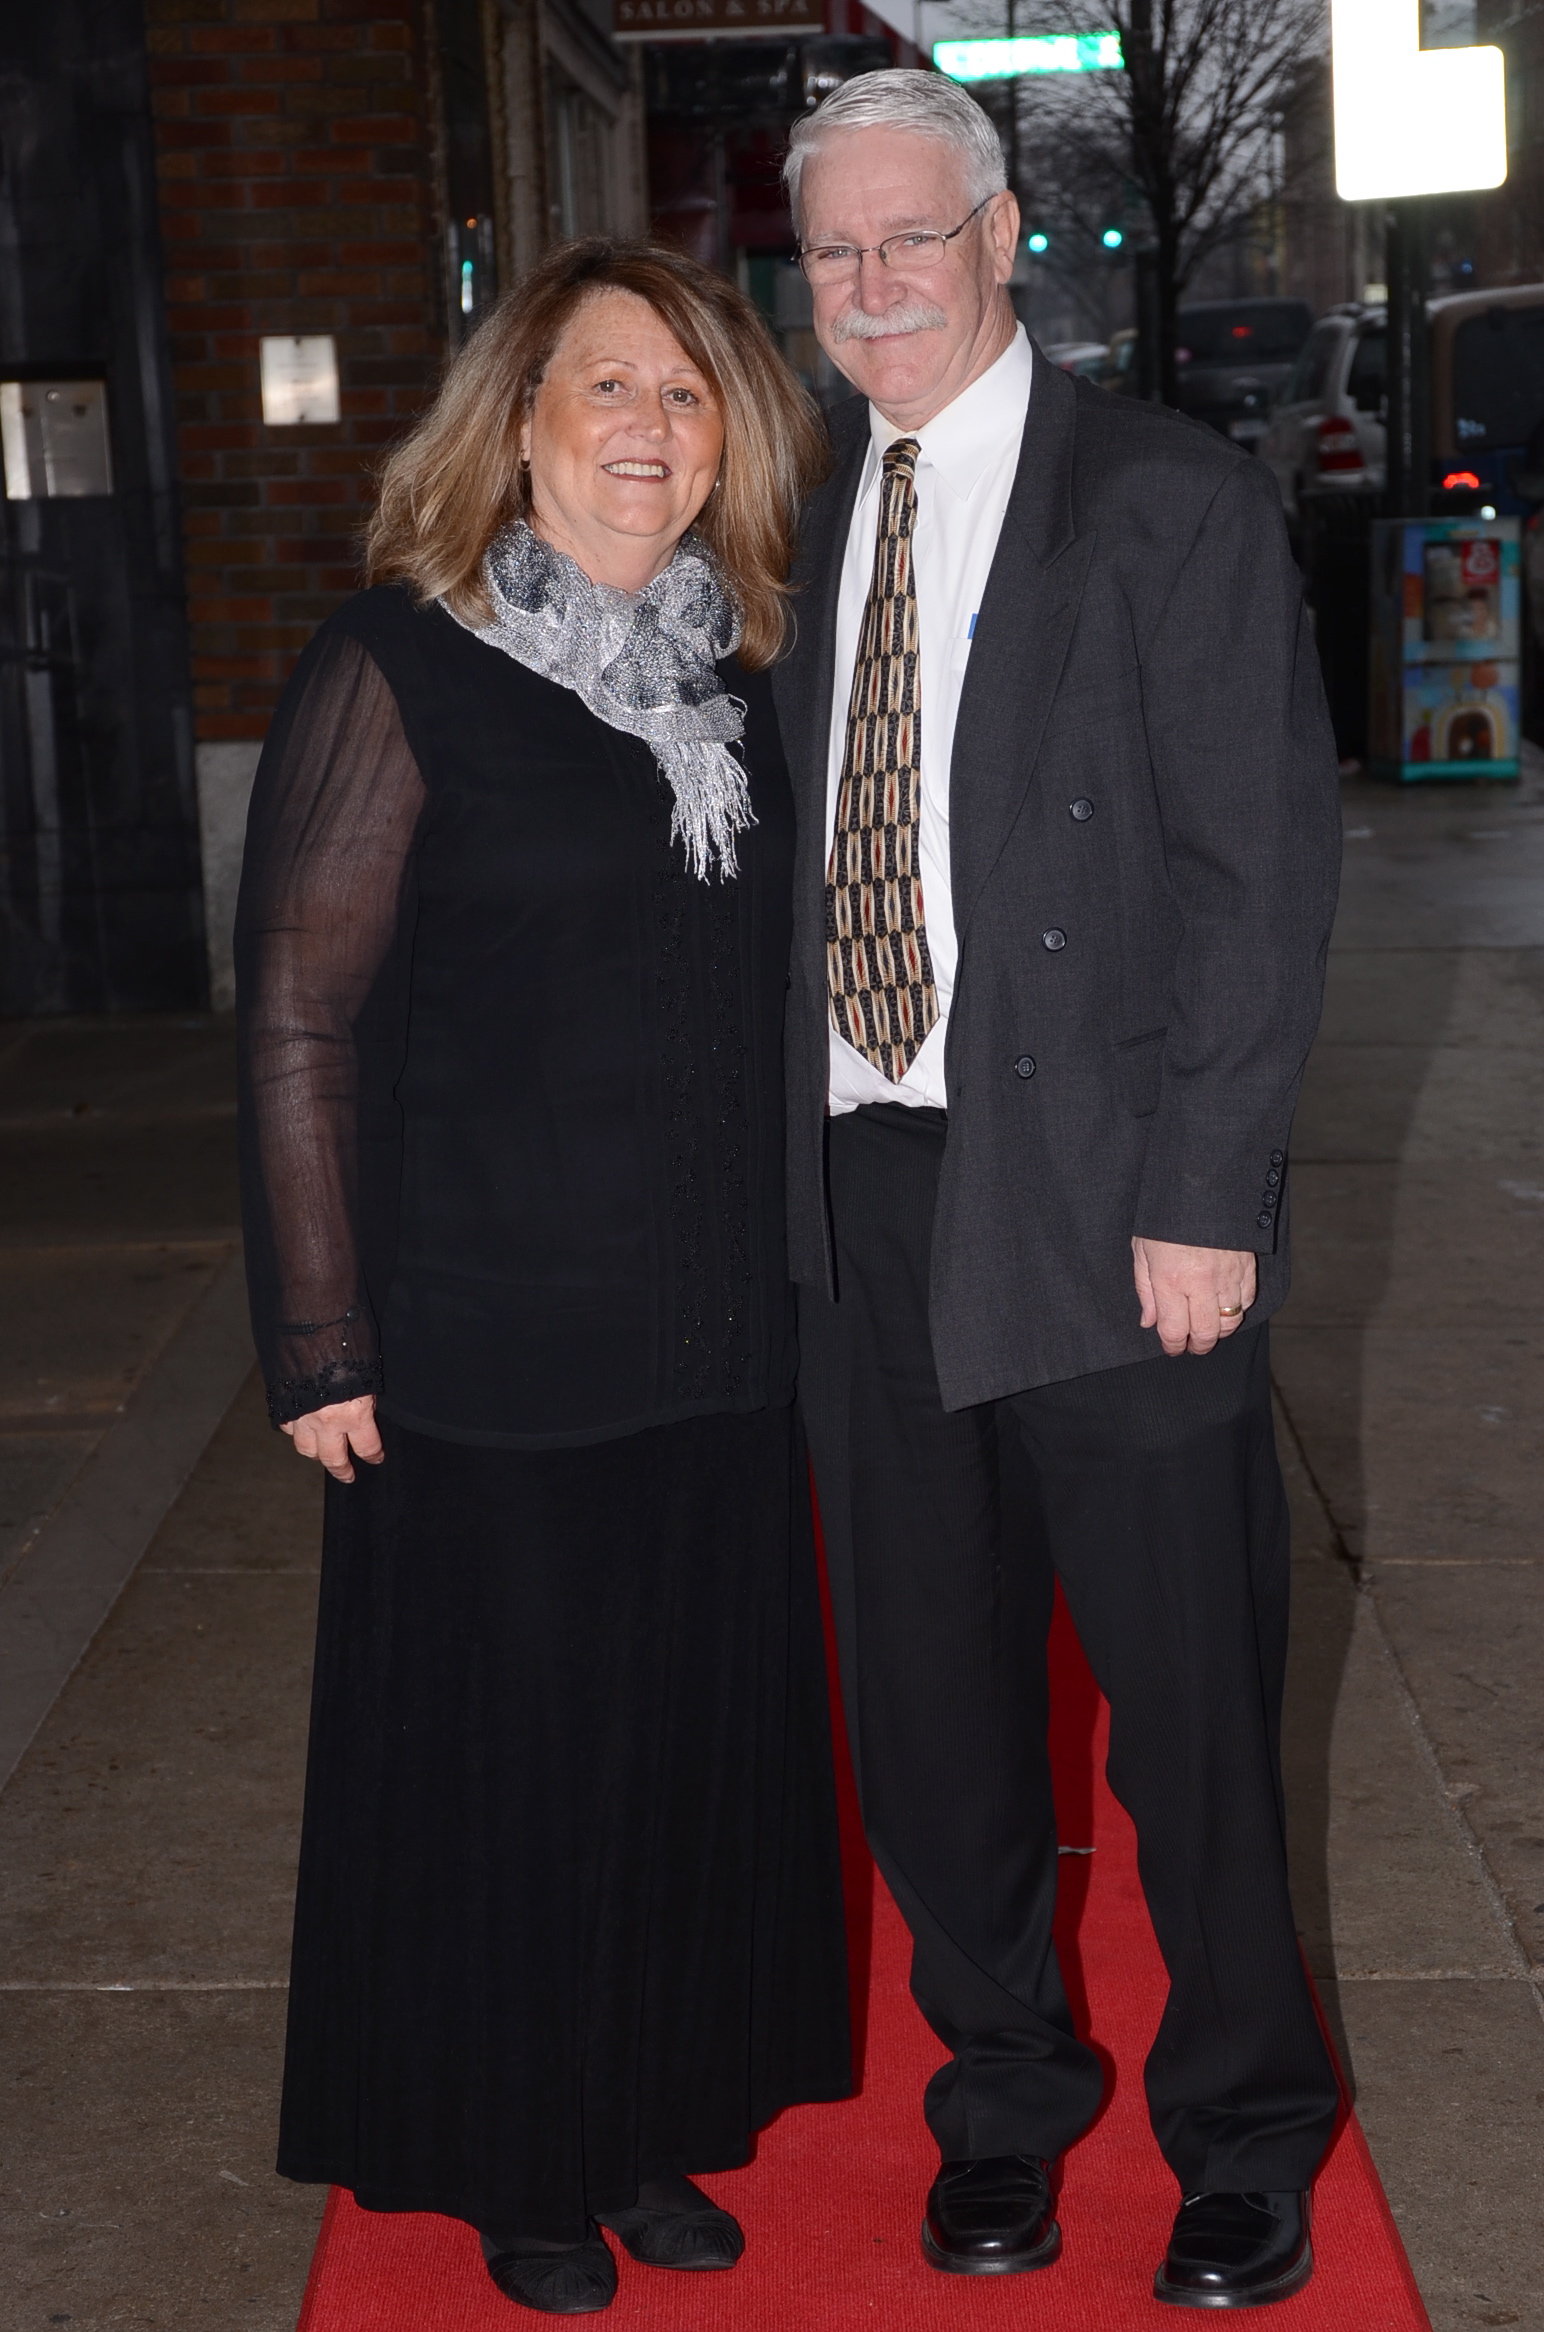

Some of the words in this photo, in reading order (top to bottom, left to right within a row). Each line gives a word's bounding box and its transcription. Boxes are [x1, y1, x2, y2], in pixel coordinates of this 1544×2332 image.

[619, 0, 714, 20] SALON
[725, 0, 745, 17] &
[757, 0, 809, 15] SPA
